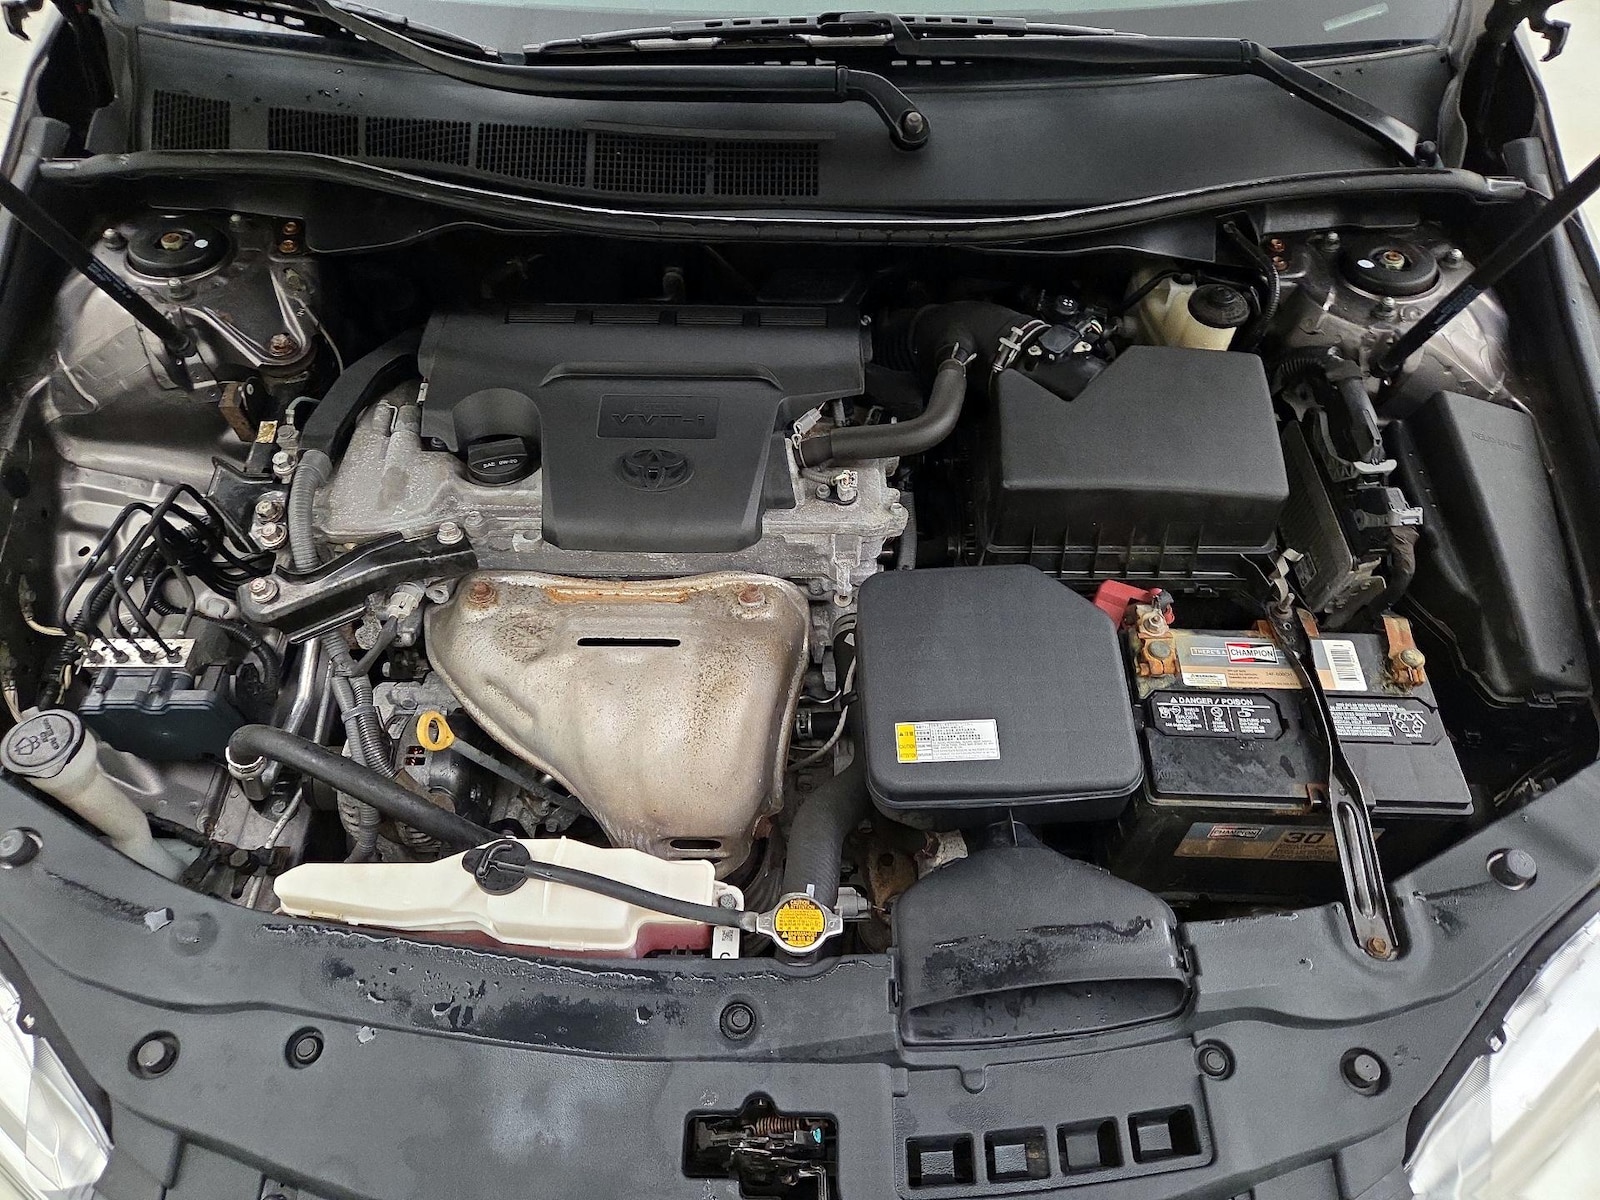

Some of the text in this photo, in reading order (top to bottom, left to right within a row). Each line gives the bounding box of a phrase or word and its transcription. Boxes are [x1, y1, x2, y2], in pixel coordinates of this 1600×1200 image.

[611, 413, 705, 426] VVT-i
[483, 460, 496, 468] SAE
[1230, 648, 1274, 658] CHAMPION
[1179, 697, 1213, 705] DANGER
[1221, 698, 1253, 706] POISON
[1213, 828, 1258, 837] CHAMPION
[1284, 832, 1326, 844] 30
